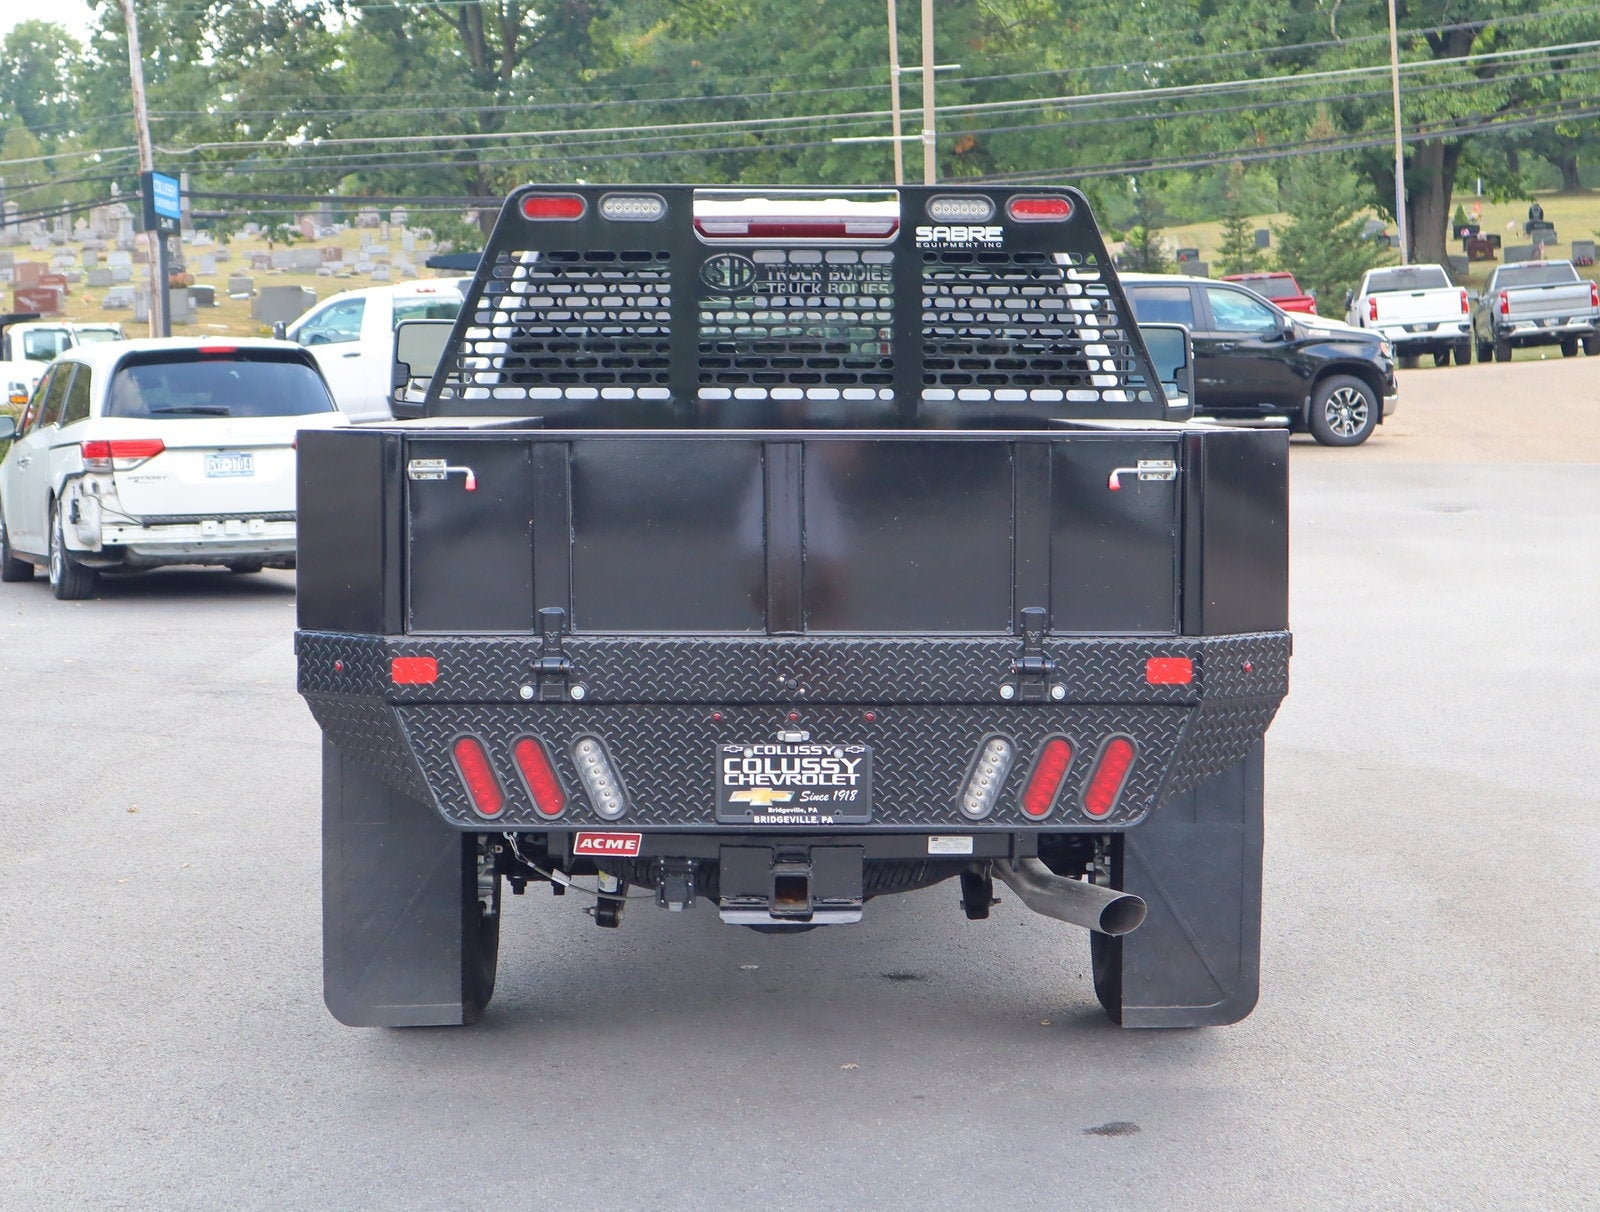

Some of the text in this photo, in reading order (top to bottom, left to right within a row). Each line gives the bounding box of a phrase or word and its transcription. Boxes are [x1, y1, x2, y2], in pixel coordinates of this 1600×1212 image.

[915, 226, 1004, 242] SABRE
[764, 264, 893, 281] TRUCK BODIES
[753, 745, 836, 755] COLUSSY
[723, 758, 862, 774] COLUSSY
[723, 774, 860, 786] CHEVROLET
[799, 789, 858, 802] Since 1918
[821, 815, 834, 824] PA
[579, 838, 637, 850] ACME
